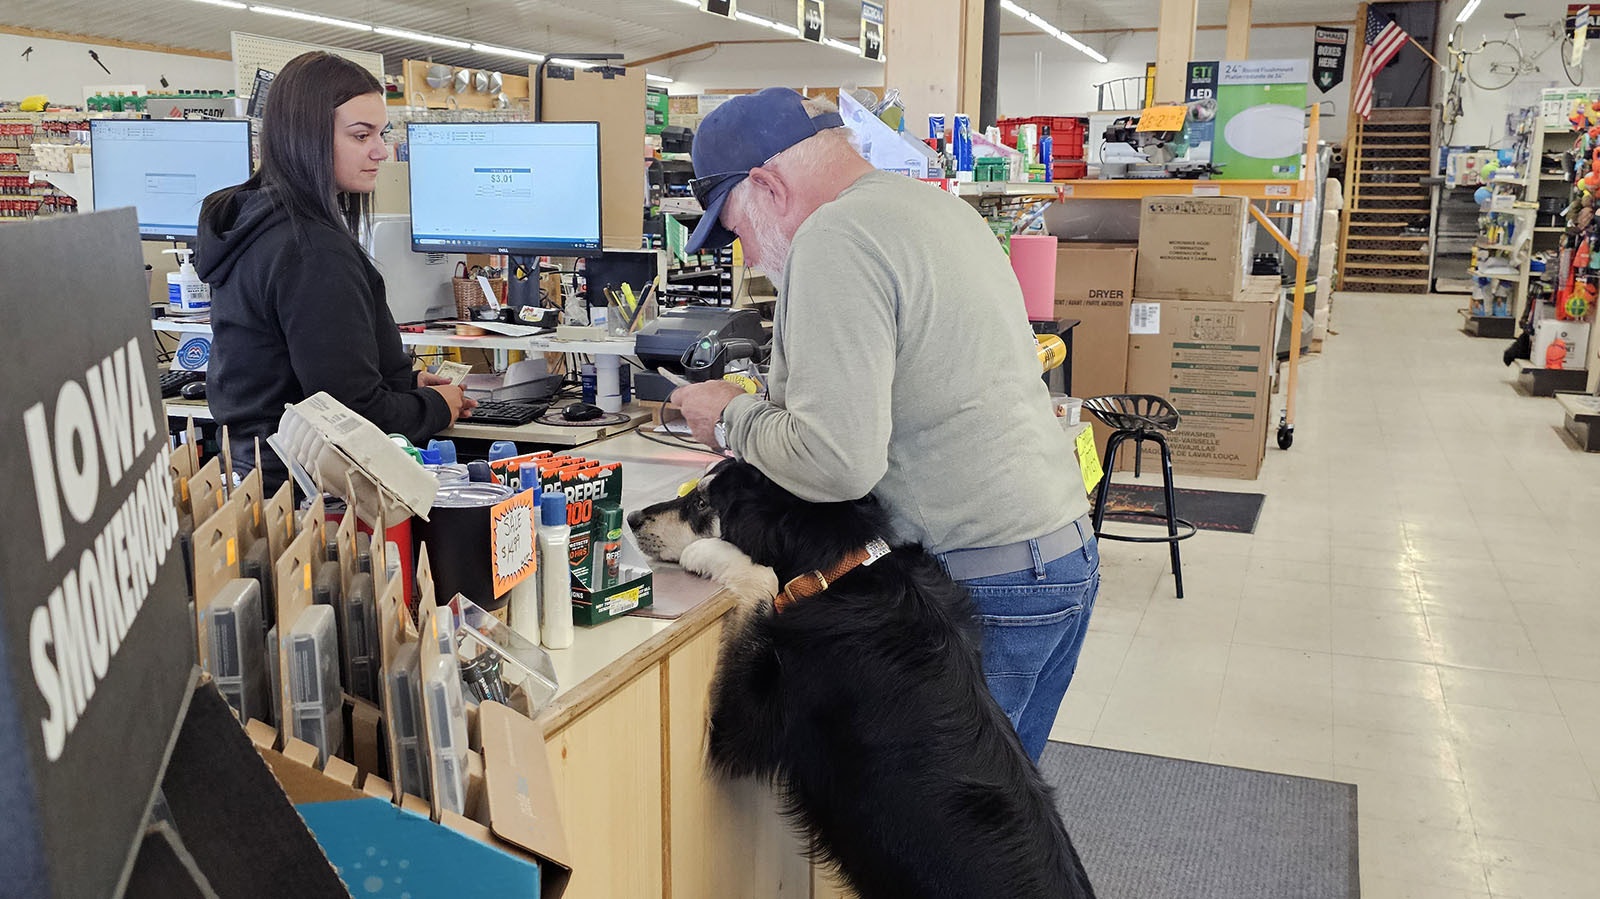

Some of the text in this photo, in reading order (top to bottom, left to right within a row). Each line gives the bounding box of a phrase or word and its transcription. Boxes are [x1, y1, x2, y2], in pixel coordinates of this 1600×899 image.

[1317, 45, 1342, 57] BOXES
[1318, 57, 1338, 68] HERE
[1192, 66, 1213, 79] ETI
[1190, 88, 1213, 99] LED
[490, 174, 513, 183] $3.01
[1089, 289, 1124, 298] DRYER
[23, 336, 157, 562] IOWA
[1169, 443, 1216, 452] AVAVAJILLAS
[564, 478, 609, 504] REPEL
[566, 499, 593, 527] 100
[29, 442, 180, 763] SMOKEHOUSE
